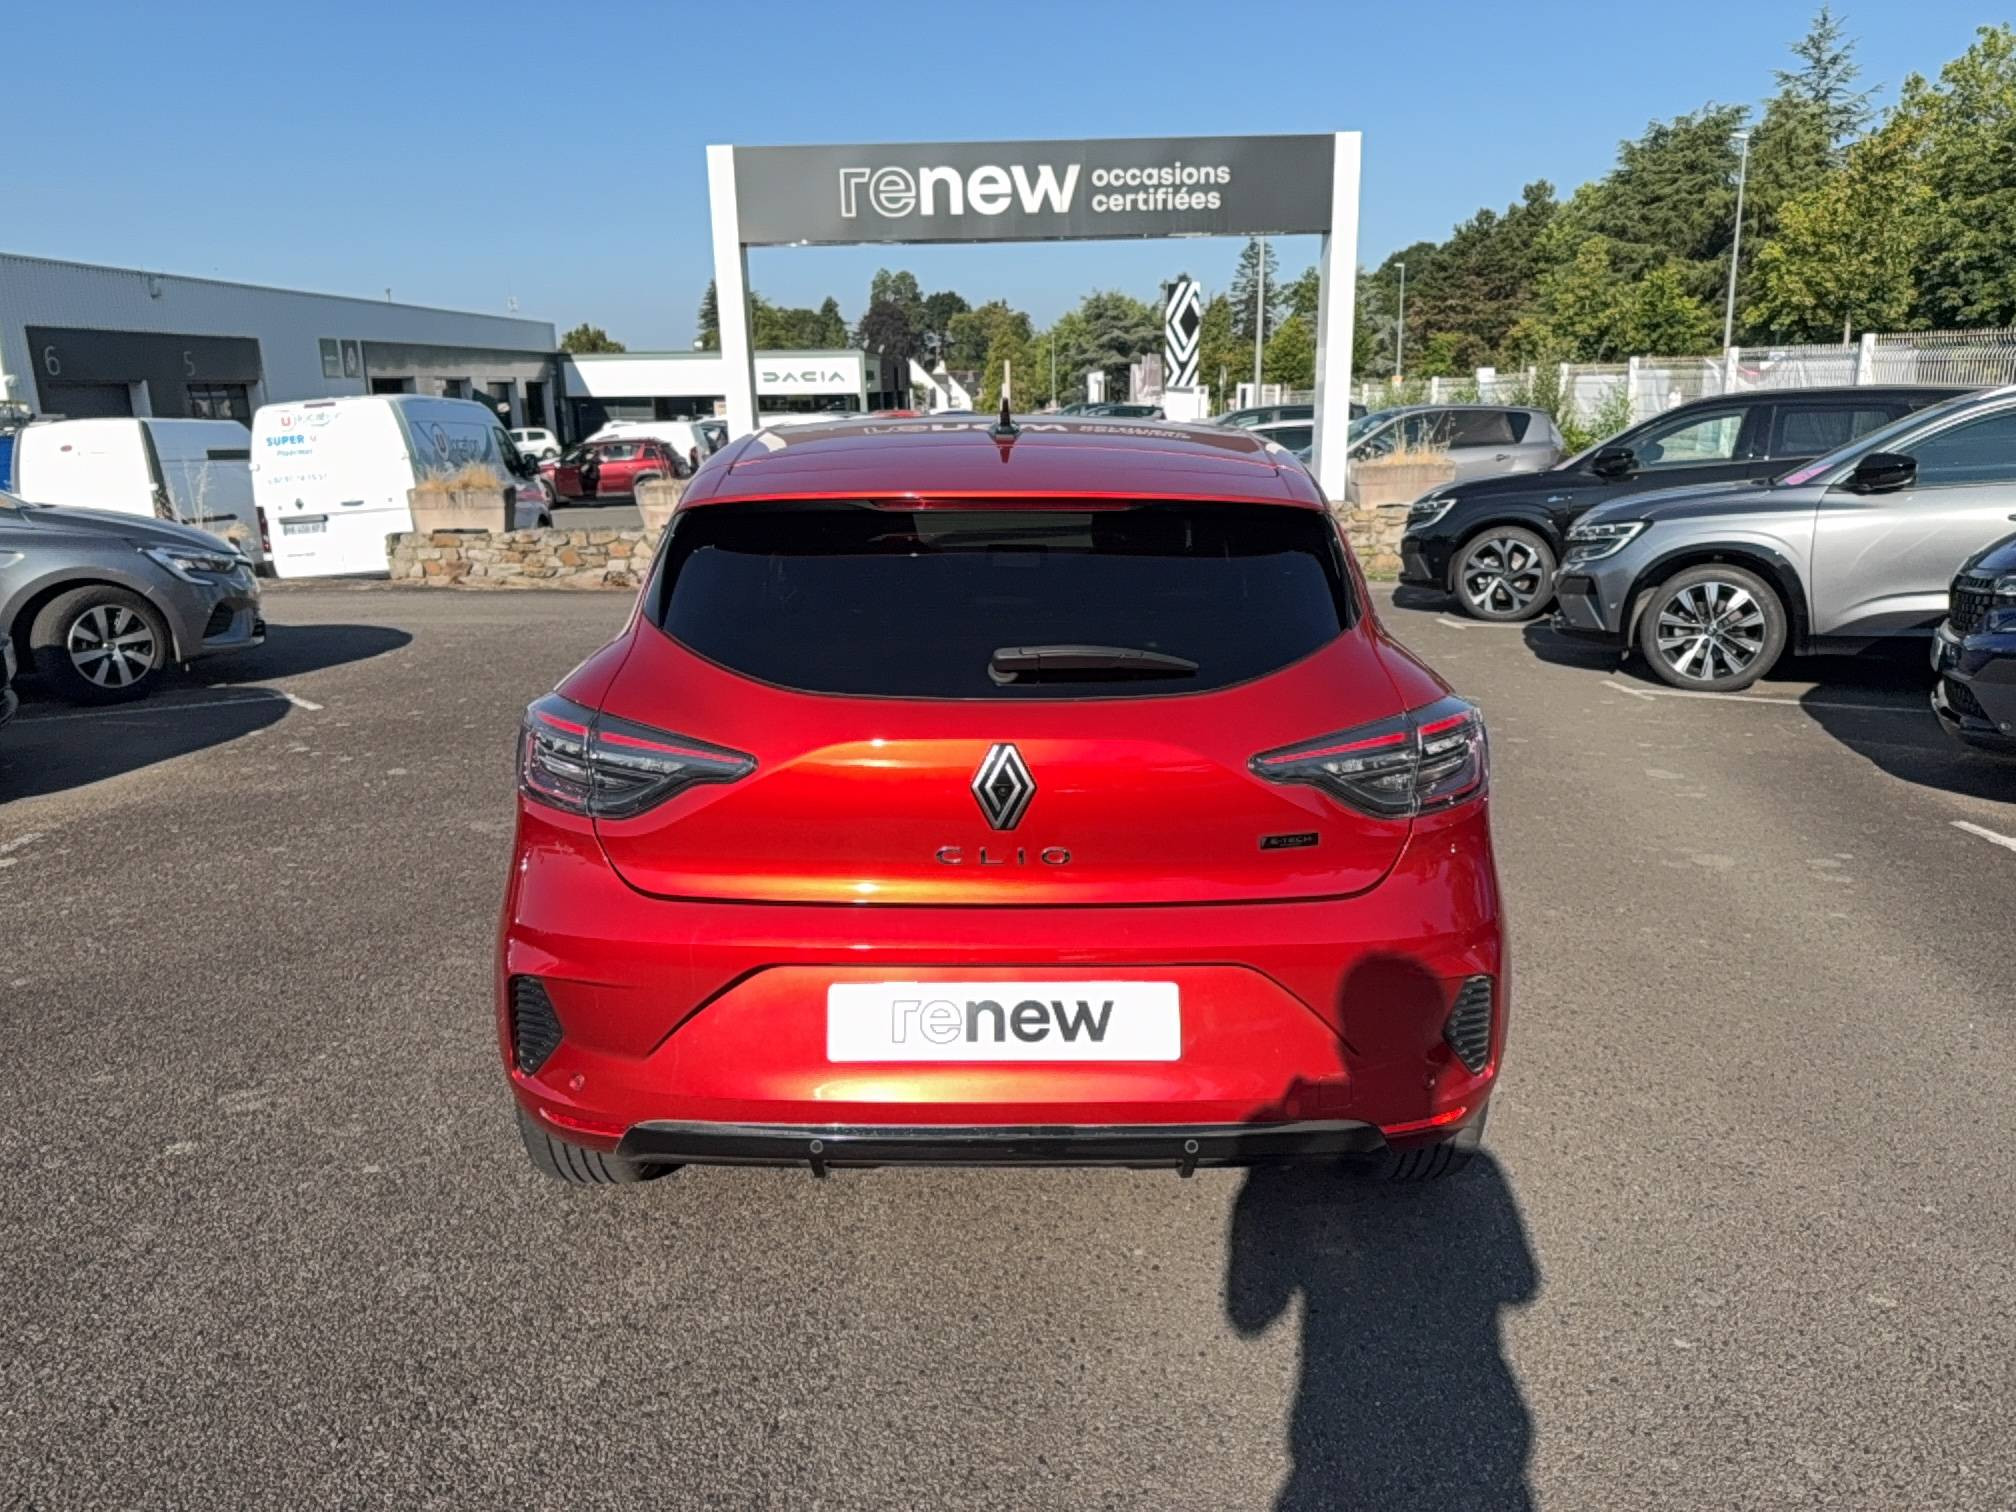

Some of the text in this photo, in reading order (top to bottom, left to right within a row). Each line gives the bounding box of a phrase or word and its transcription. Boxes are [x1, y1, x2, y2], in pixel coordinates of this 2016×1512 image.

[1091, 162, 1231, 187] occasions
[839, 163, 1081, 218] renew
[1091, 187, 1222, 212] certifiées
[44, 345, 61, 376] 6
[183, 350, 196, 377] 5
[762, 370, 846, 383] DACIA
[265, 434, 305, 447] SUPER
[936, 845, 1071, 865] CLIO
[891, 999, 1115, 1045] renew
